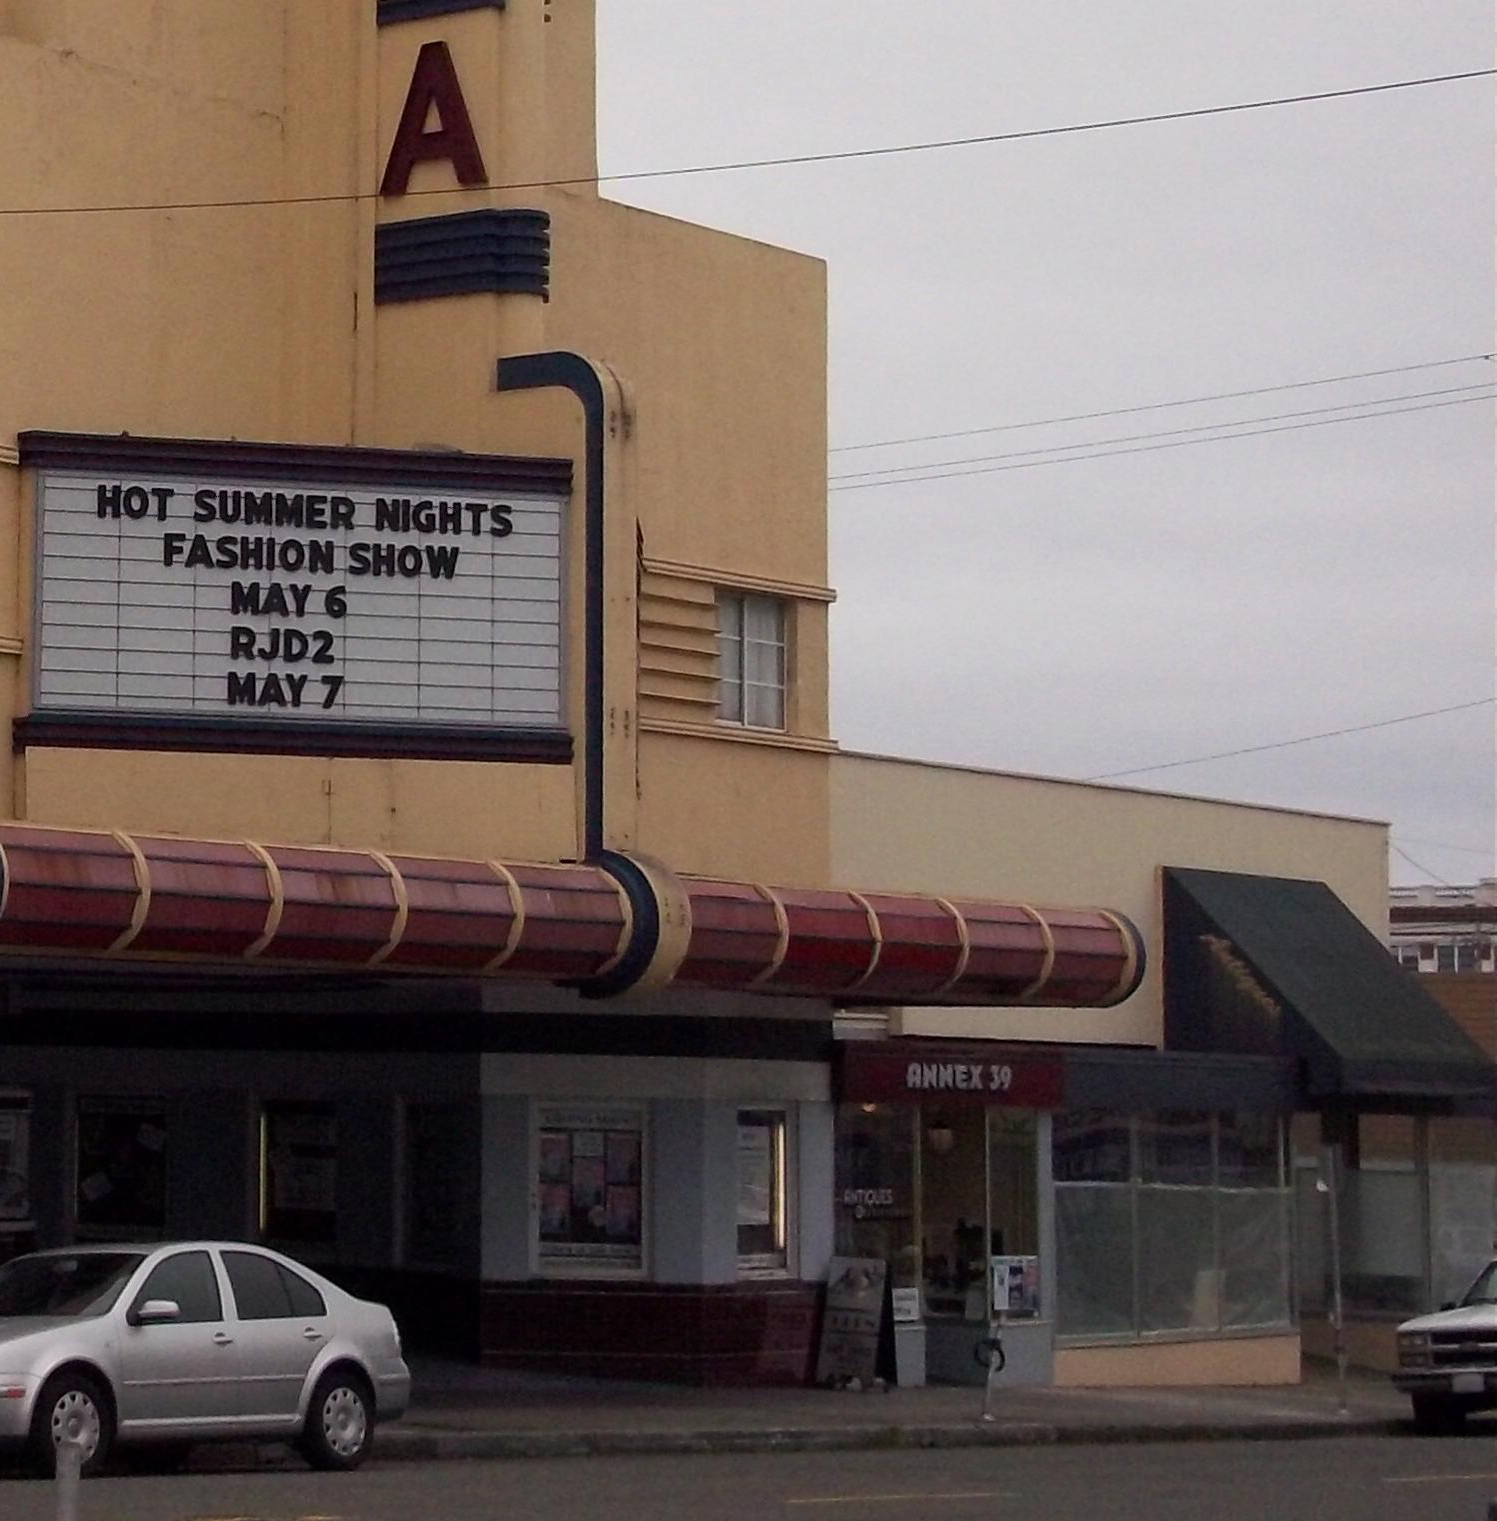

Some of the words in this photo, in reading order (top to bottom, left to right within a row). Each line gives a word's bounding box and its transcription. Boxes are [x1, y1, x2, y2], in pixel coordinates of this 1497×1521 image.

[96, 484, 174, 521] HOT
[193, 489, 356, 531] SUMMER
[375, 497, 514, 537] NIGHTS
[163, 533, 334, 575] FASHION
[348, 542, 459, 580] SHOW
[230, 581, 311, 617] MAY
[324, 585, 348, 618] 6
[230, 626, 335, 664] RJD2
[227, 672, 308, 707] MAY
[321, 675, 344, 709] 7
[906, 1062, 984, 1090] ANNEX
[989, 1064, 1013, 1091] 39
